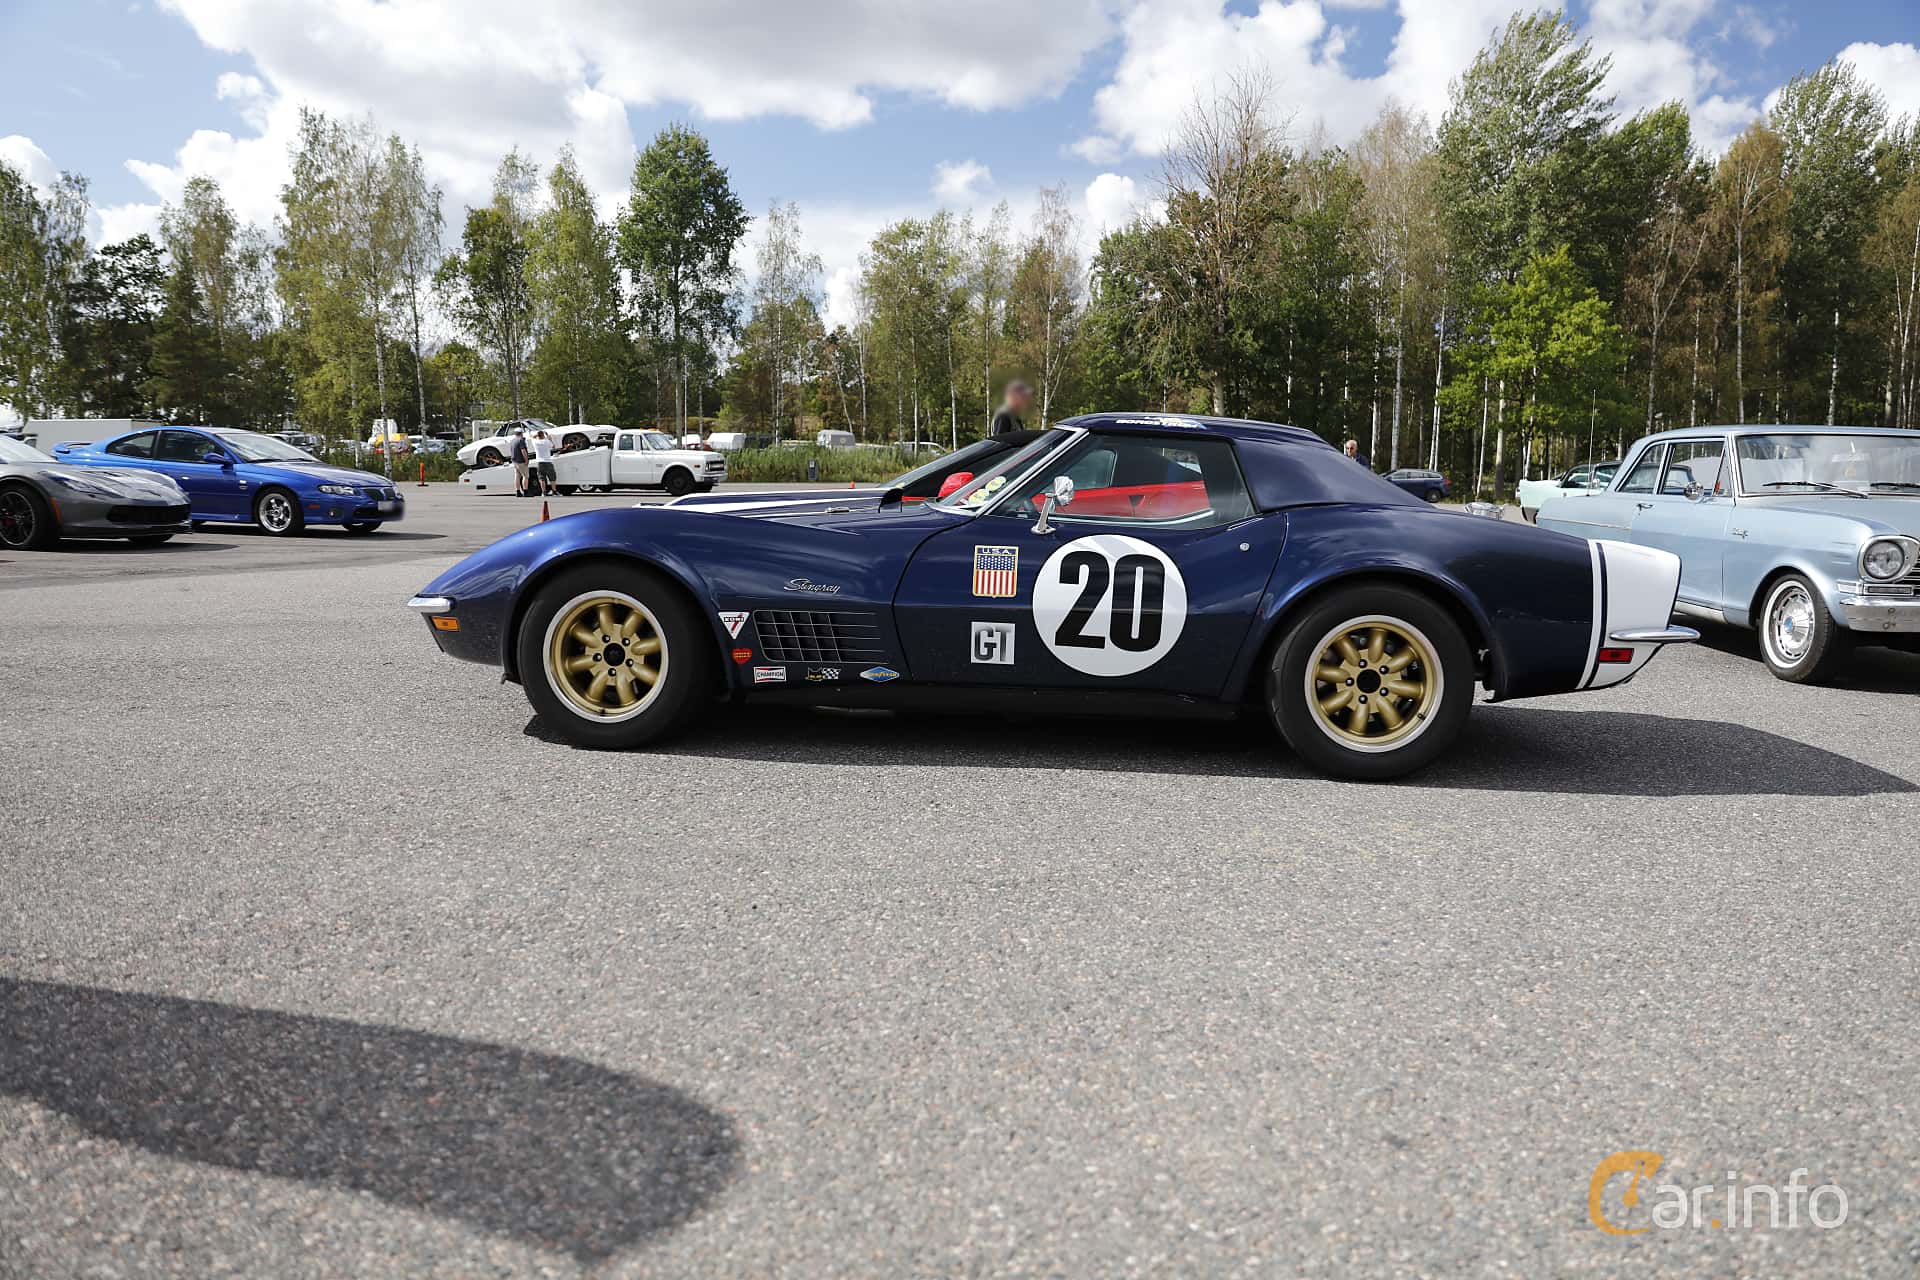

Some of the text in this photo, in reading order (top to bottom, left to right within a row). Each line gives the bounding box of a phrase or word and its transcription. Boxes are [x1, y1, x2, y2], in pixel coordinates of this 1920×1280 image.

[783, 578, 841, 594] Stingray
[1054, 550, 1166, 652] 20
[974, 626, 1012, 662] GT
